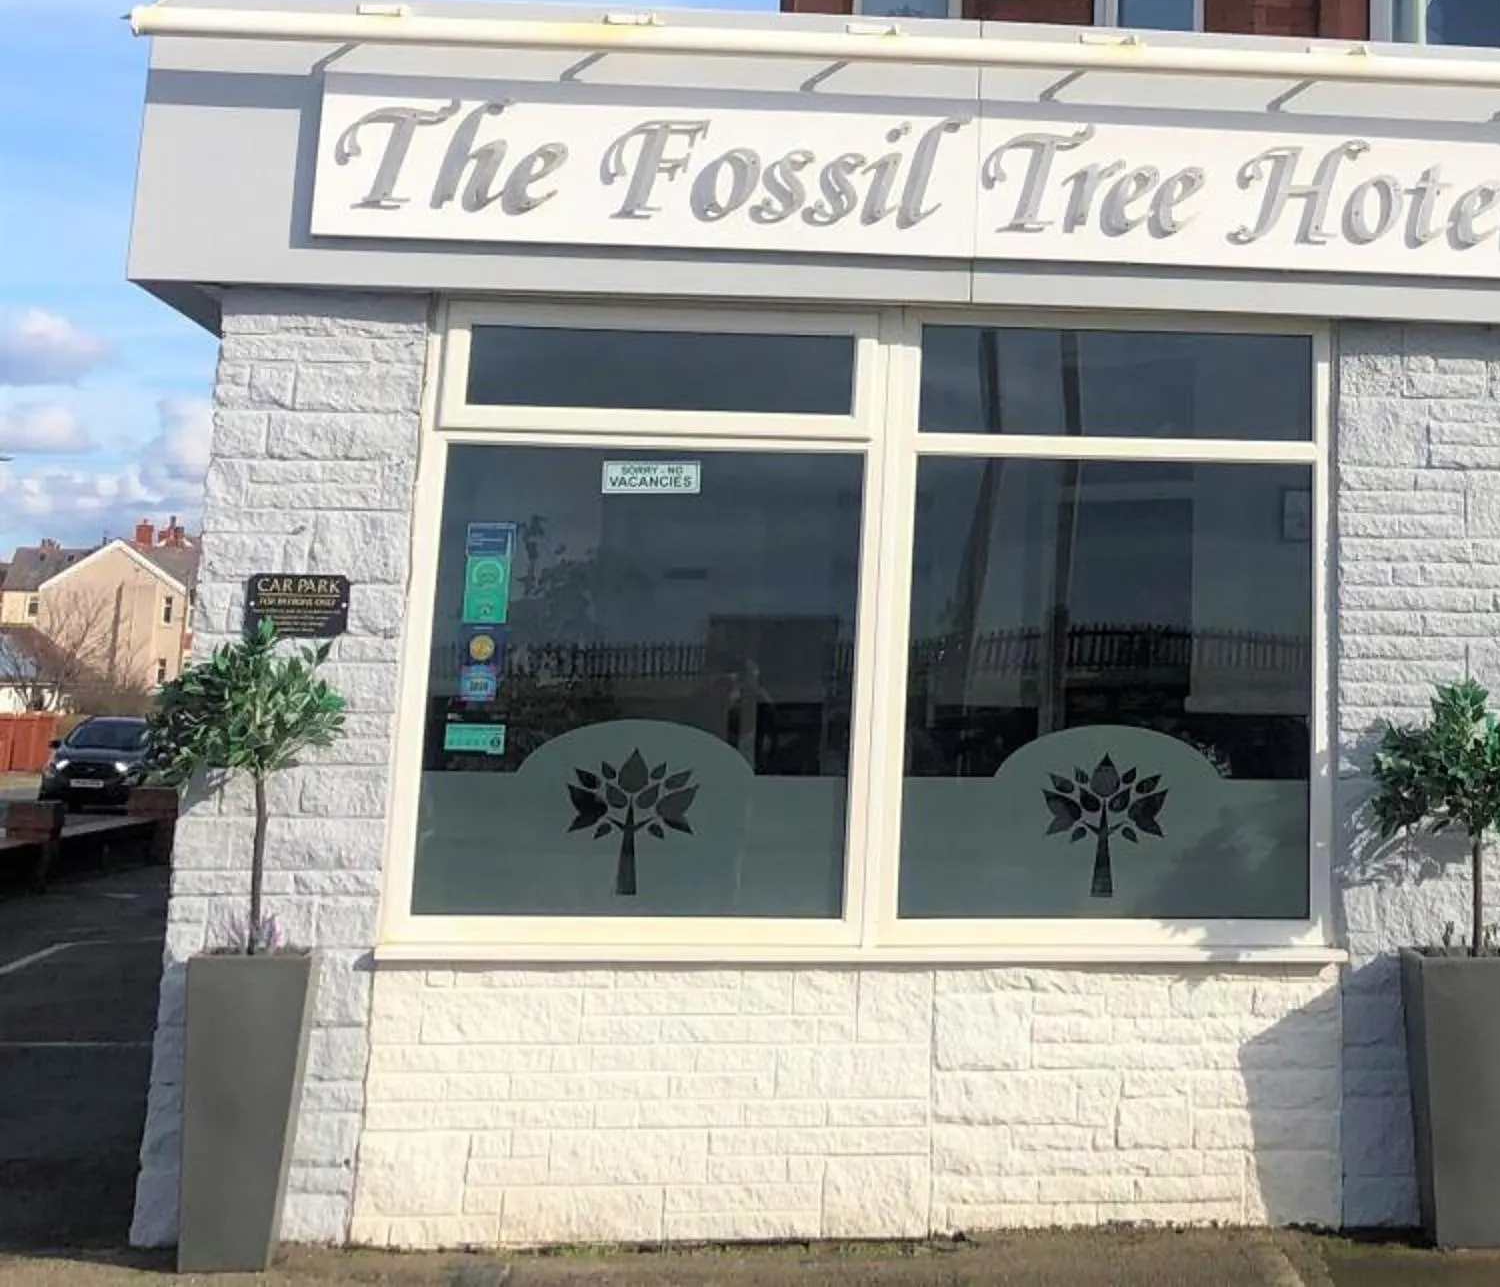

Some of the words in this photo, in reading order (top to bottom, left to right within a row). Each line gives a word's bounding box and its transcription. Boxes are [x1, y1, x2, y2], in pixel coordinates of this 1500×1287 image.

[335, 97, 569, 216] The
[599, 113, 977, 230] Fossil
[981, 123, 1208, 239] Tree
[609, 476, 692, 488] VACANCIES
[257, 578, 294, 593] CAR
[297, 579, 341, 594] PARK
